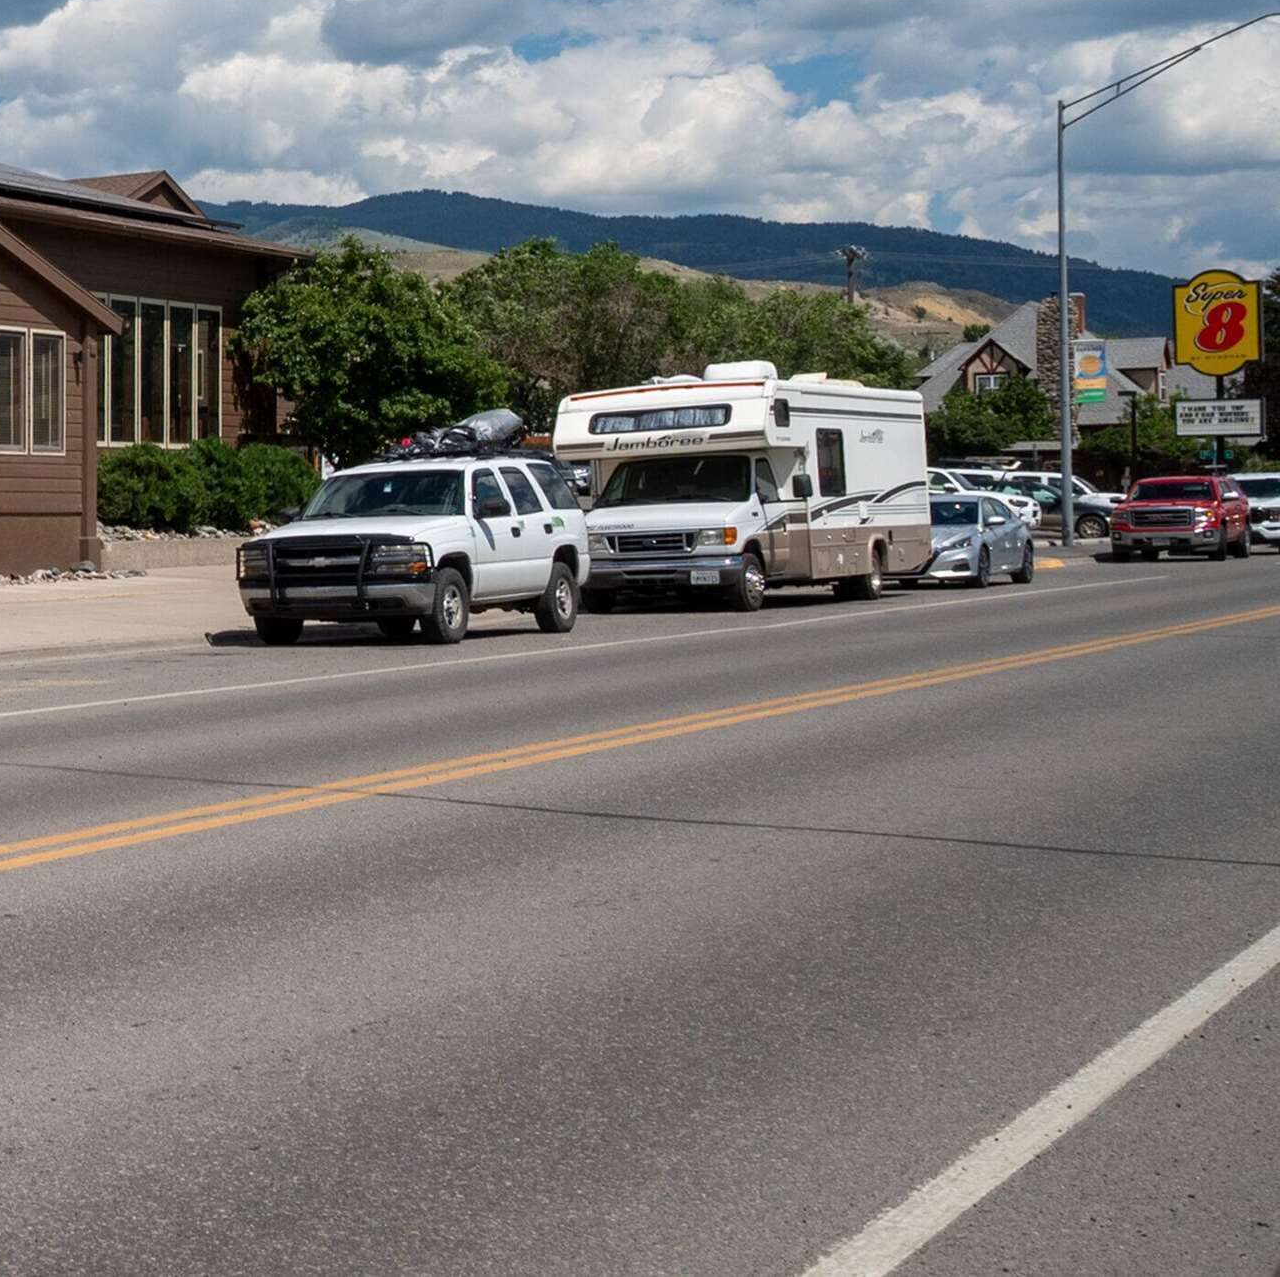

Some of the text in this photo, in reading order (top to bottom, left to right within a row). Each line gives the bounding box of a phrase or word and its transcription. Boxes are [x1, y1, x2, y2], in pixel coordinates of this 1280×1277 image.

[1186, 282, 1247, 311] Super
[1195, 301, 1247, 353] 8
[606, 435, 705, 451] Jamboree
